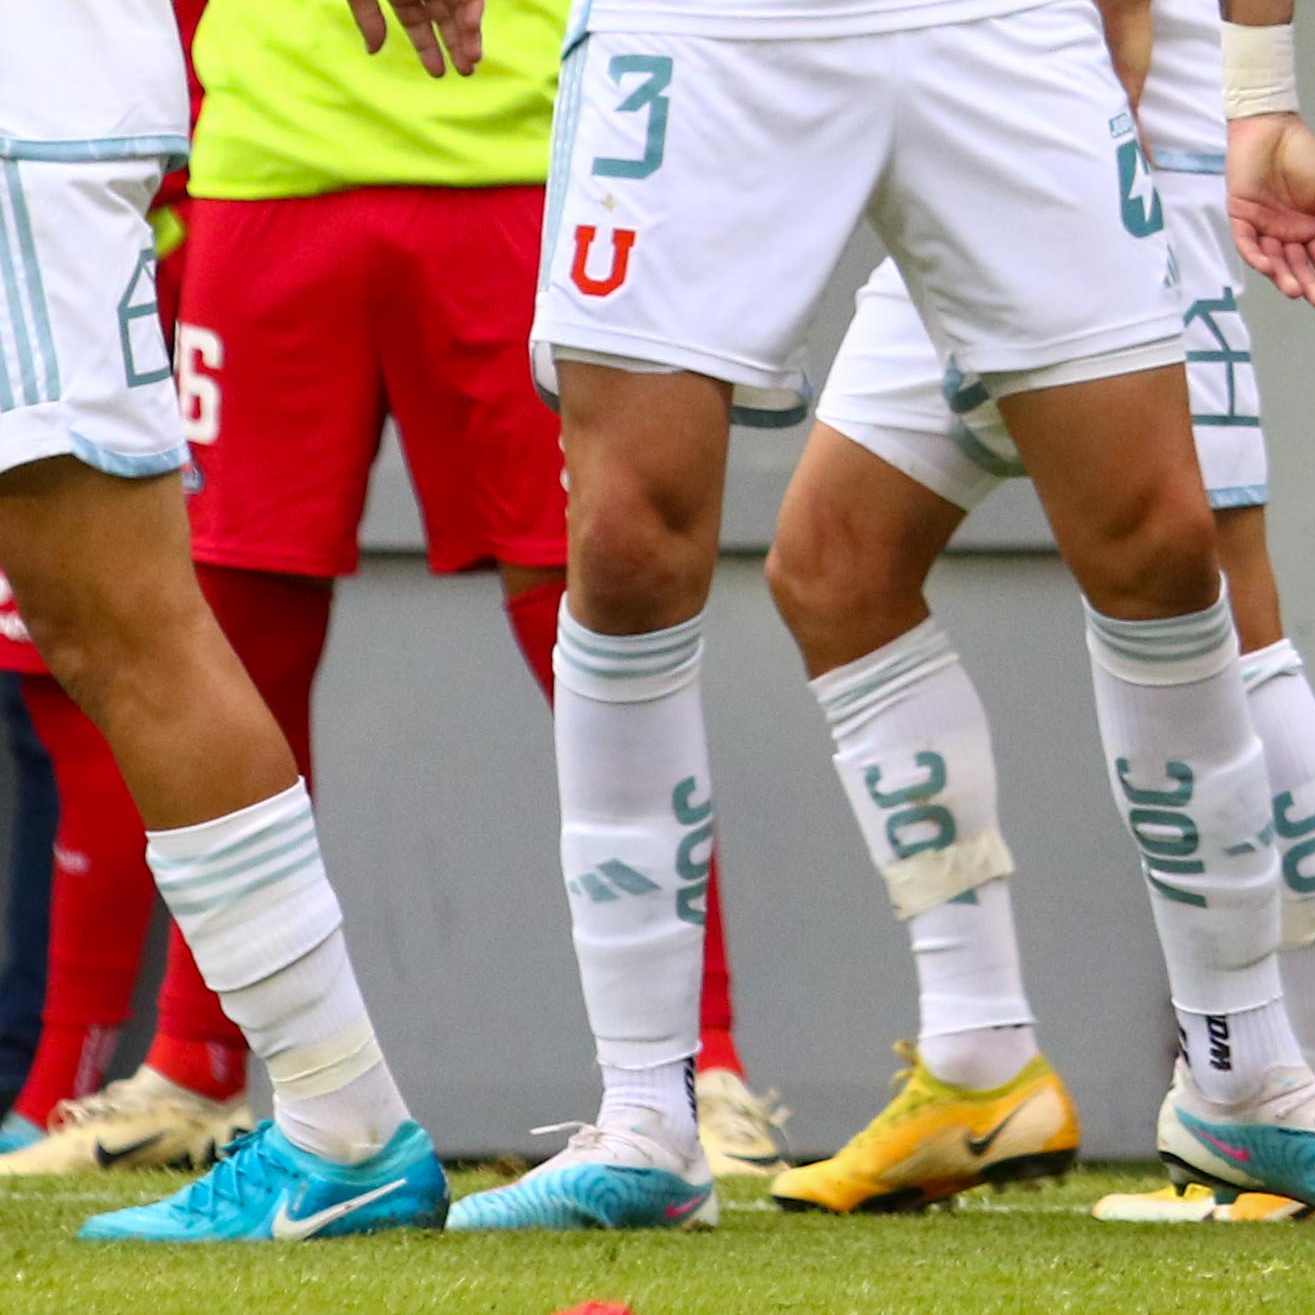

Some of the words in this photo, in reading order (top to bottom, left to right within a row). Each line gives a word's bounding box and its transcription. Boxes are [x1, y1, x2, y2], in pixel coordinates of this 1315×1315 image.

[592, 54, 673, 179] 3
[570, 225, 635, 296] U
[174, 320, 224, 446] 6
